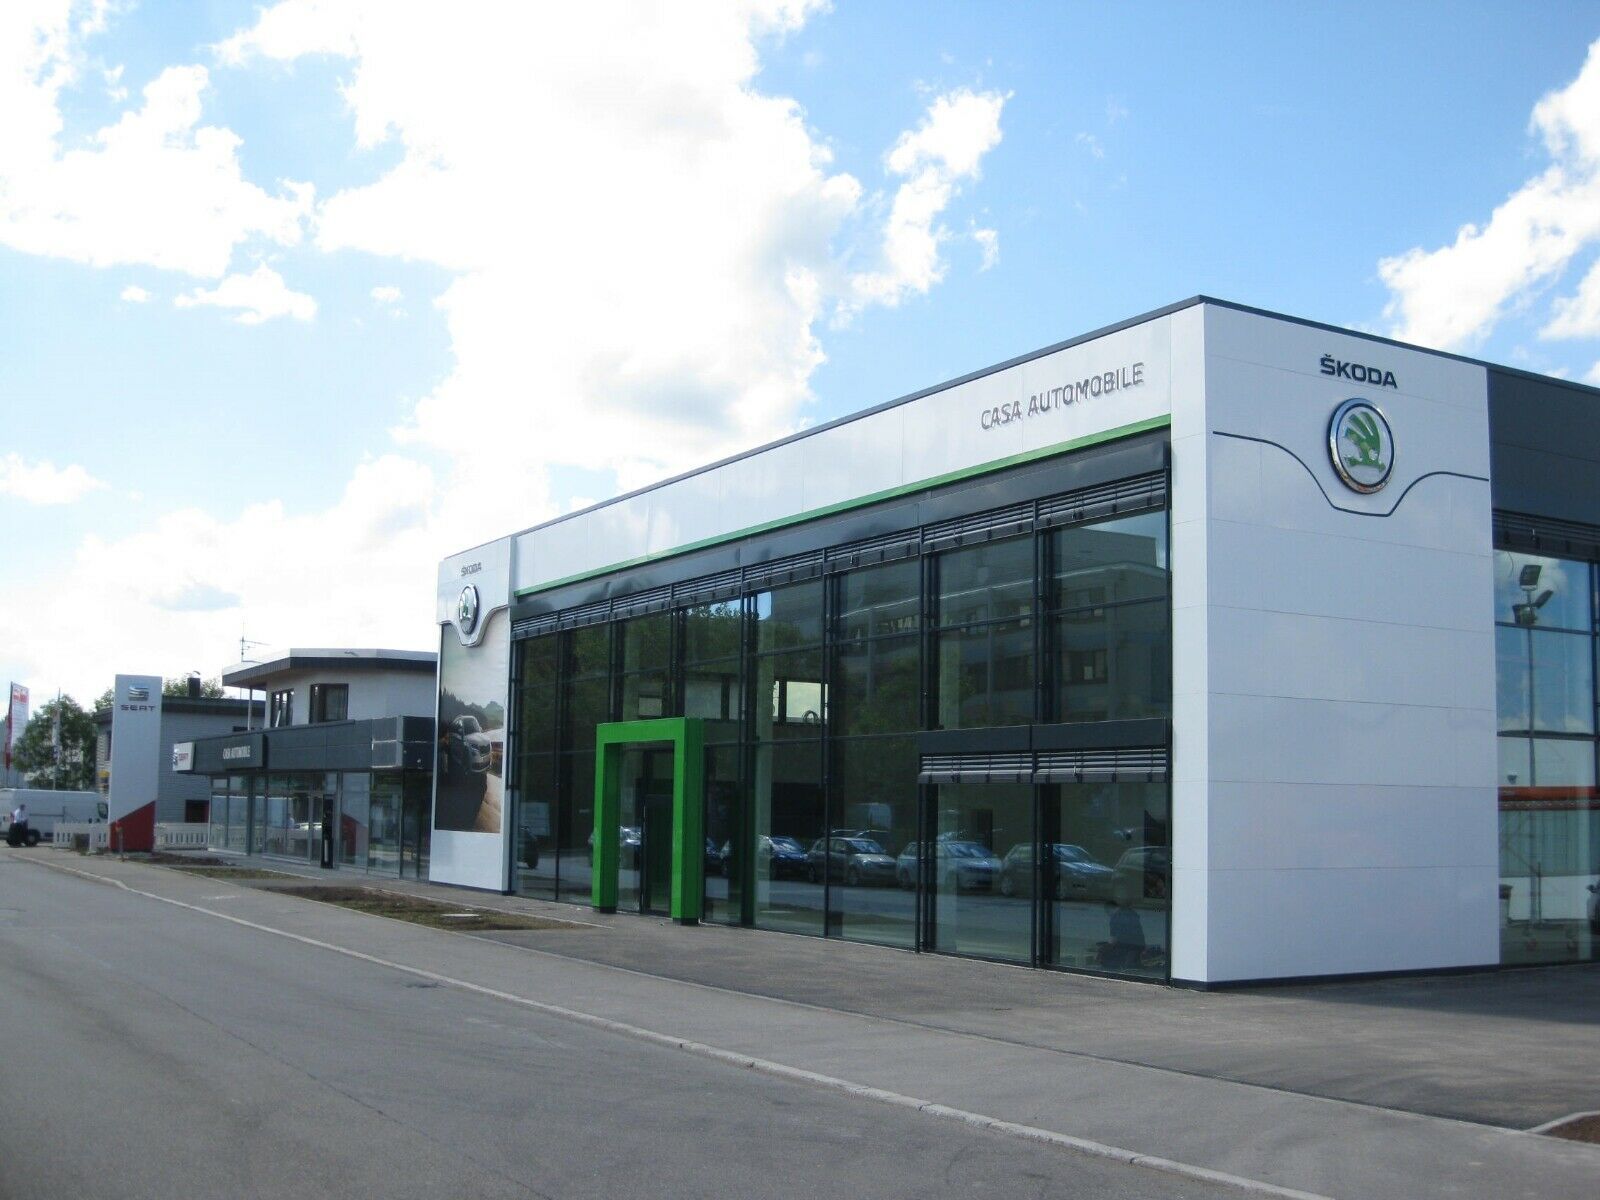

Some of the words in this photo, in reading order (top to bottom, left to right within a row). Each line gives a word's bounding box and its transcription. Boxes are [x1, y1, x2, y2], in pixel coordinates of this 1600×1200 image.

[981, 400, 1022, 430] CASA
[1027, 361, 1145, 417] AUTOMOBILE
[1320, 353, 1398, 389] ŠKODA
